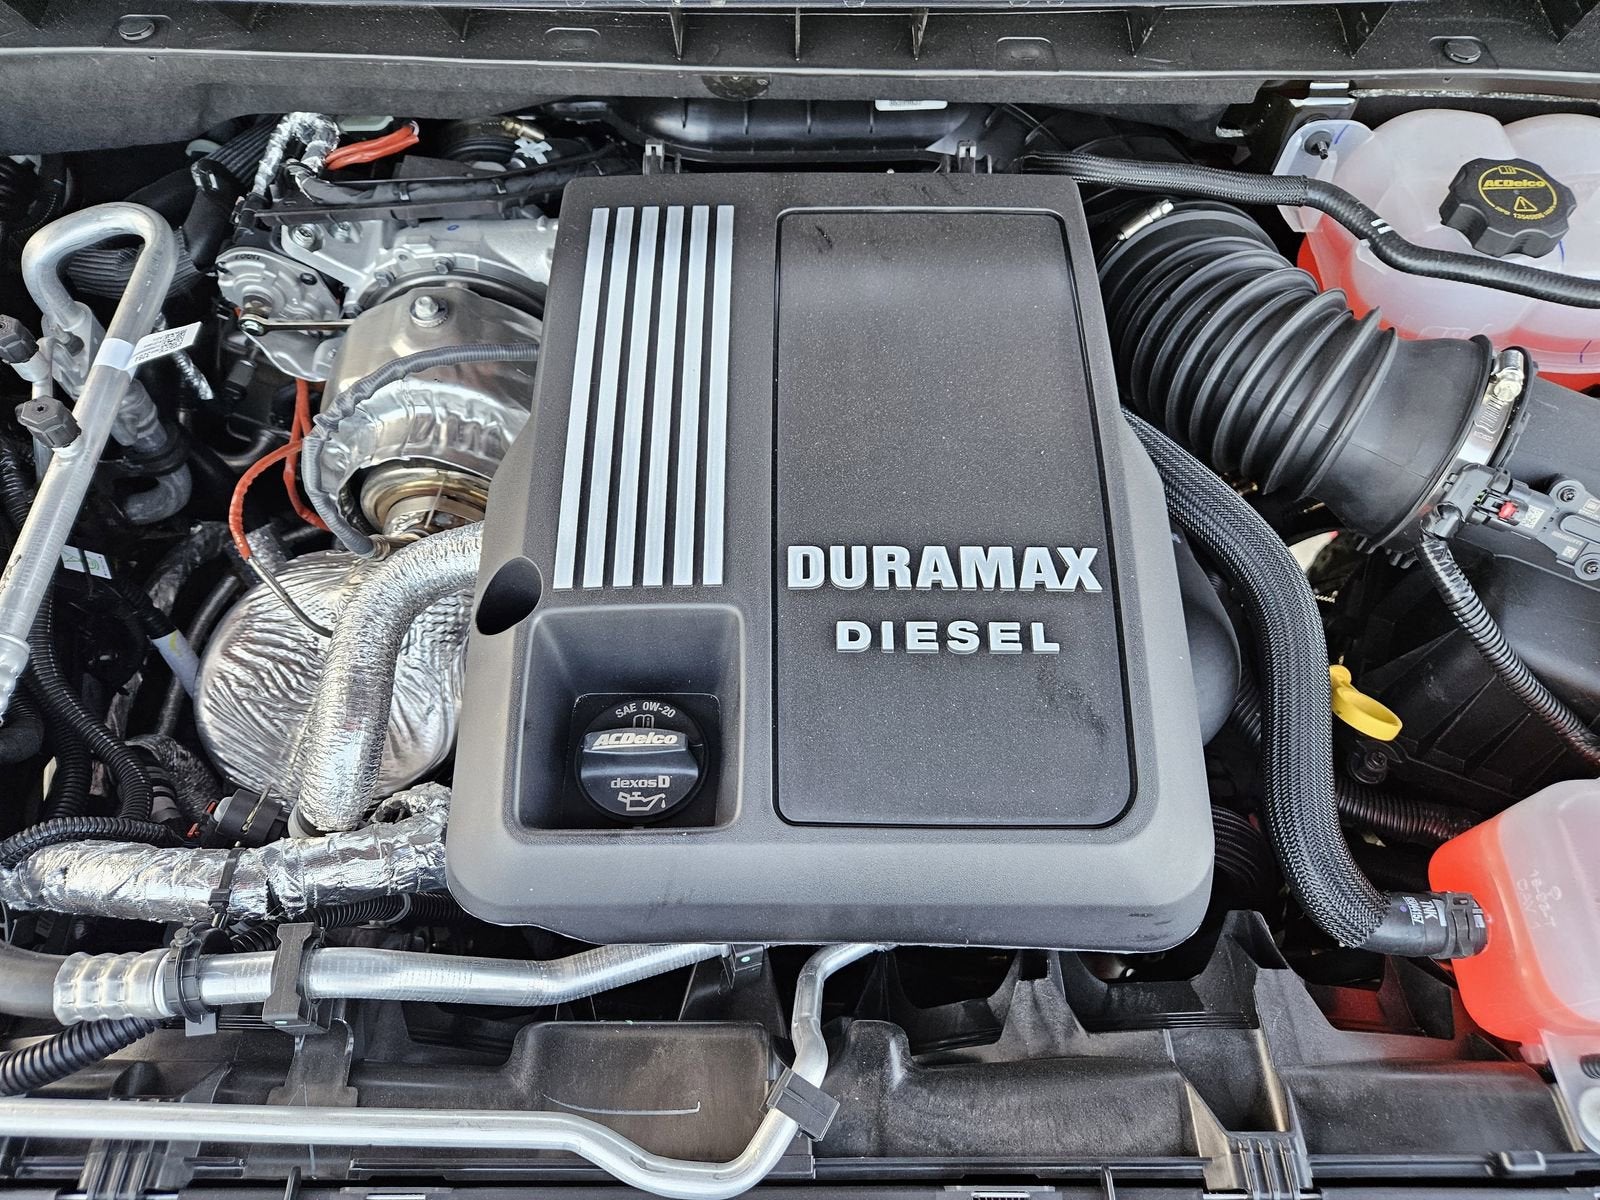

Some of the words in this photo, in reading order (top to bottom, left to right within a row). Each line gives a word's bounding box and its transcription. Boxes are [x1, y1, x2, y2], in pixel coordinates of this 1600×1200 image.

[1483, 179, 1546, 188] ACDelco
[787, 545, 1103, 592] DURAMAX
[836, 621, 1060, 655] DIESEL
[615, 702, 638, 718] SAE
[642, 701, 676, 718] 0W-20
[593, 732, 678, 748] ACDelco
[1419, 900, 1439, 920] TNK
